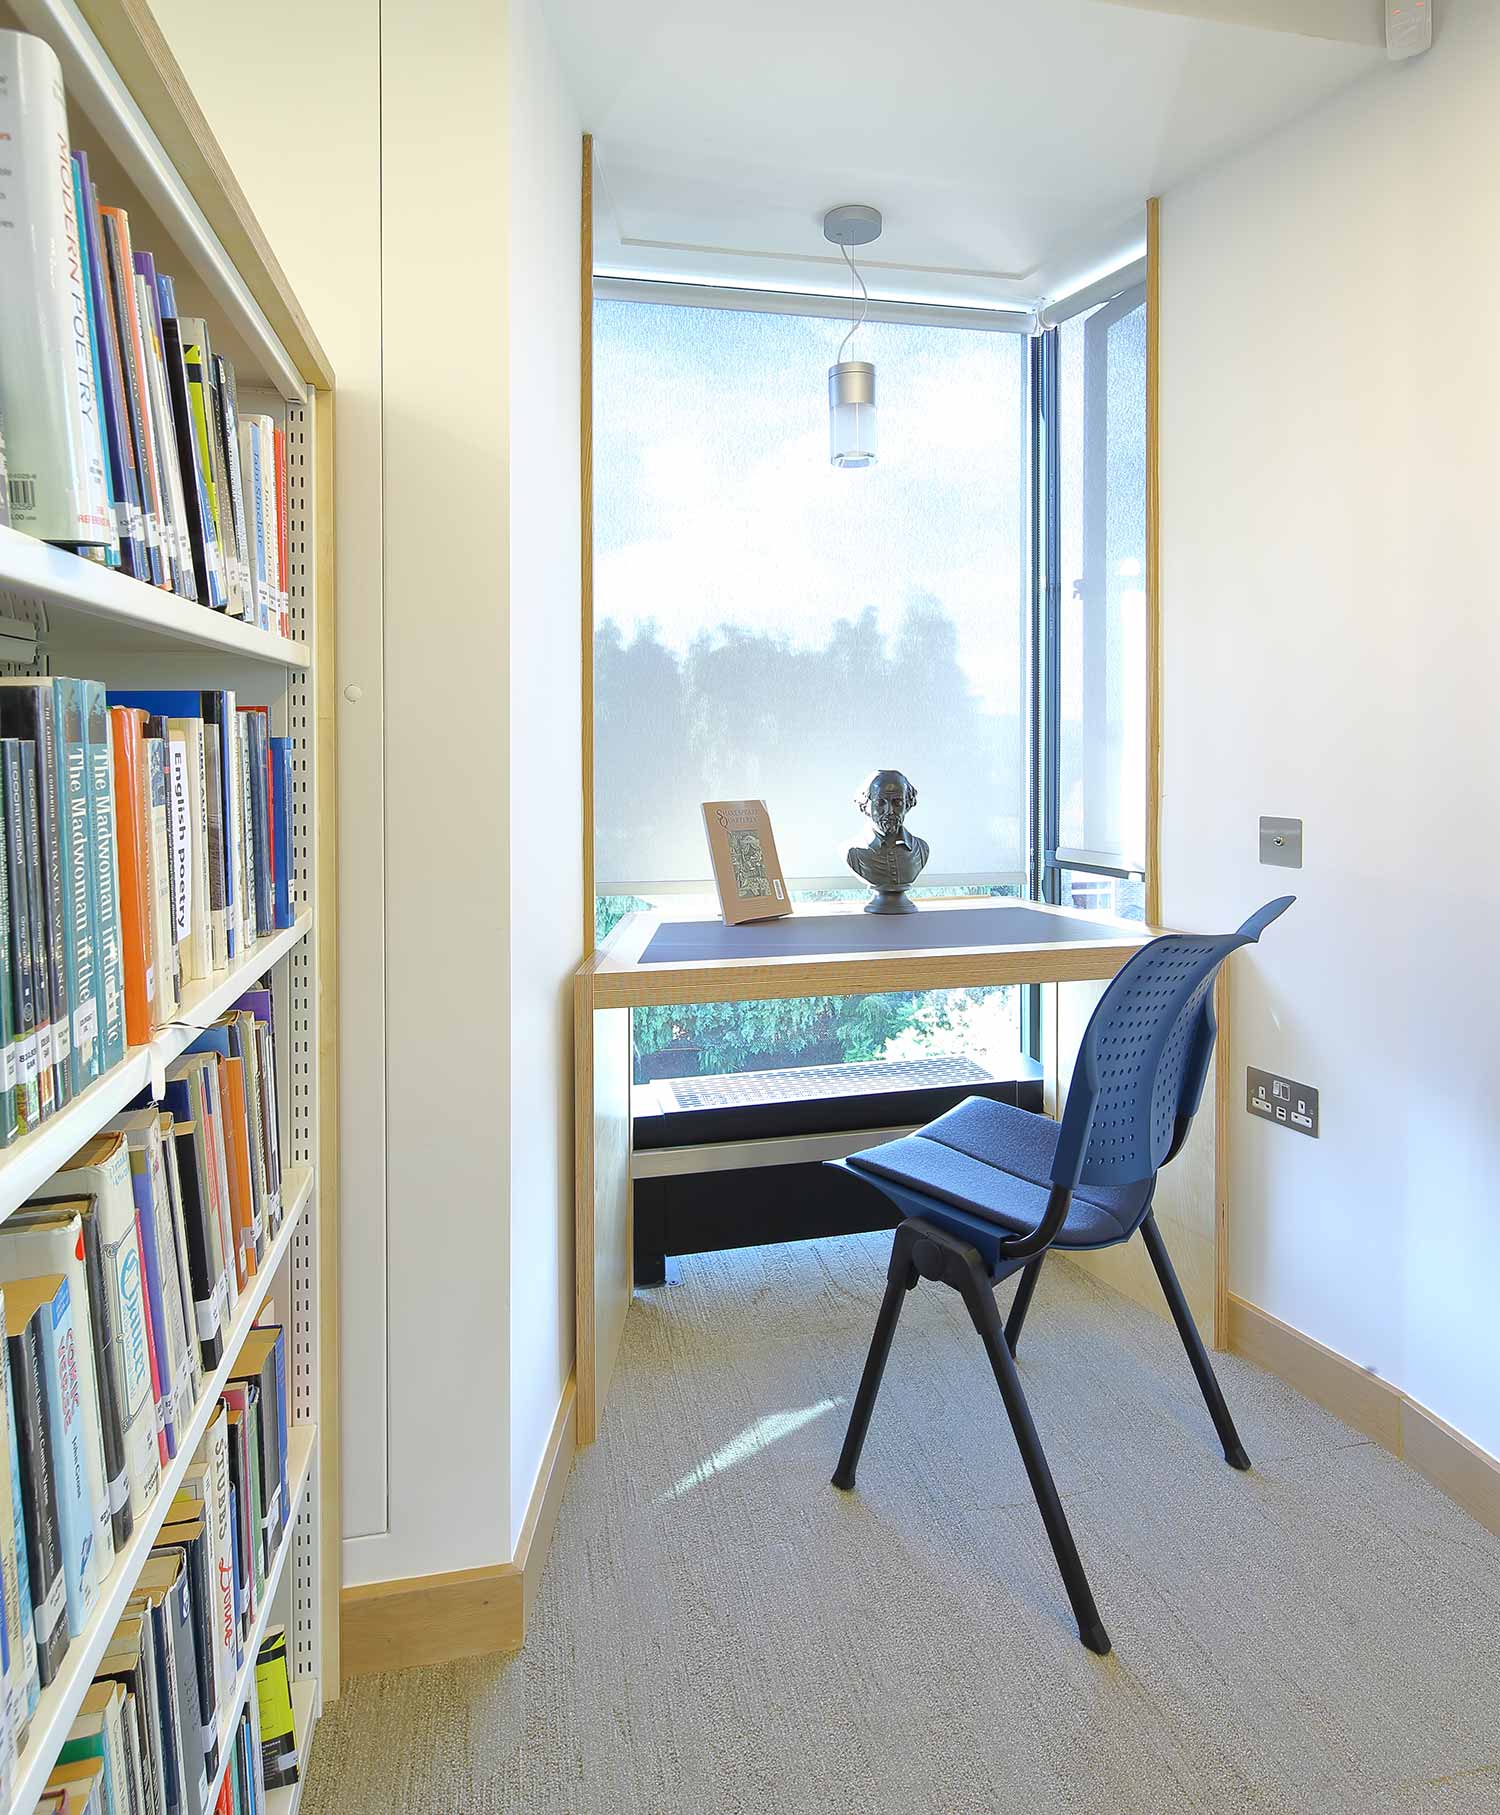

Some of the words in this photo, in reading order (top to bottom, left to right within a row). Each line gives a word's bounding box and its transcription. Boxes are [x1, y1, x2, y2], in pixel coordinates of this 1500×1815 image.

[57, 132, 80, 284] MODERN
[71, 292, 93, 424] POETRY
[255, 485, 263, 548] Sinclair
[68, 748, 85, 791] The
[94, 748, 109, 791] The
[175, 752, 187, 841] English
[12, 761, 23, 865] ECOCRITICISM
[52, 838, 60, 907] TRAVEL
[71, 797, 88, 931] Madwoman
[96, 795, 113, 921] Madwoman
[178, 847, 187, 929] poetry
[76, 935, 92, 962] in
[78, 962, 93, 1003] the
[120, 1248, 146, 1385] Chaucer
[32, 1356, 42, 1397] Oxford
[57, 1335, 73, 1436] VERSE
[66, 1327, 80, 1408] COMIC
[72, 1435, 80, 1463] John
[74, 1463, 82, 1499] Gross
[215, 1438, 228, 1541] STUBBS
[218, 1557, 234, 1647] Donne
